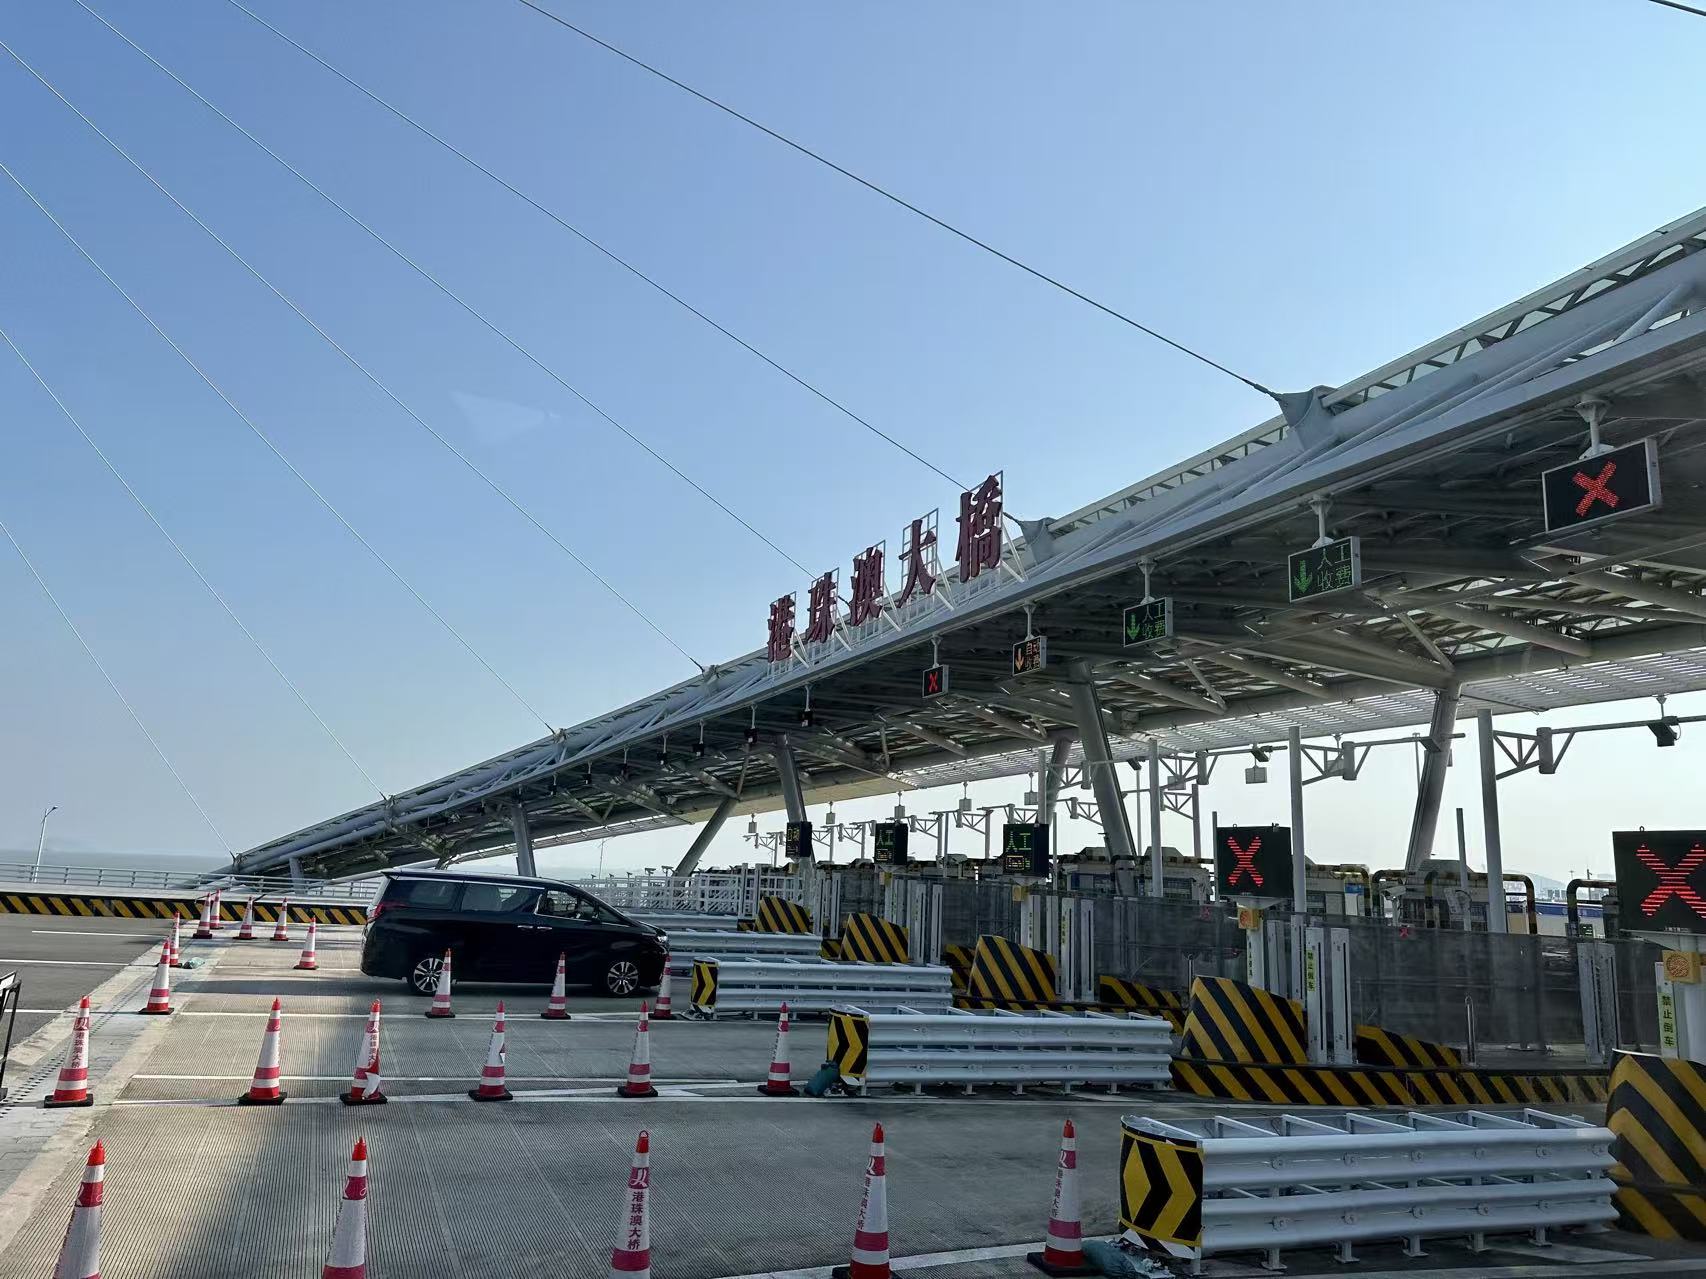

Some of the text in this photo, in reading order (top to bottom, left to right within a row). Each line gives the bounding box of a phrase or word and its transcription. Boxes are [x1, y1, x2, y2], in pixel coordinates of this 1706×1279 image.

[1317, 542, 1351, 570] 人工
[1142, 602, 1166, 623] 人工
[1005, 831, 1032, 852] 人工
[1662, 995, 1675, 1047] 禁止倒车
[627, 1191, 644, 1250] 港珠澳大桥
